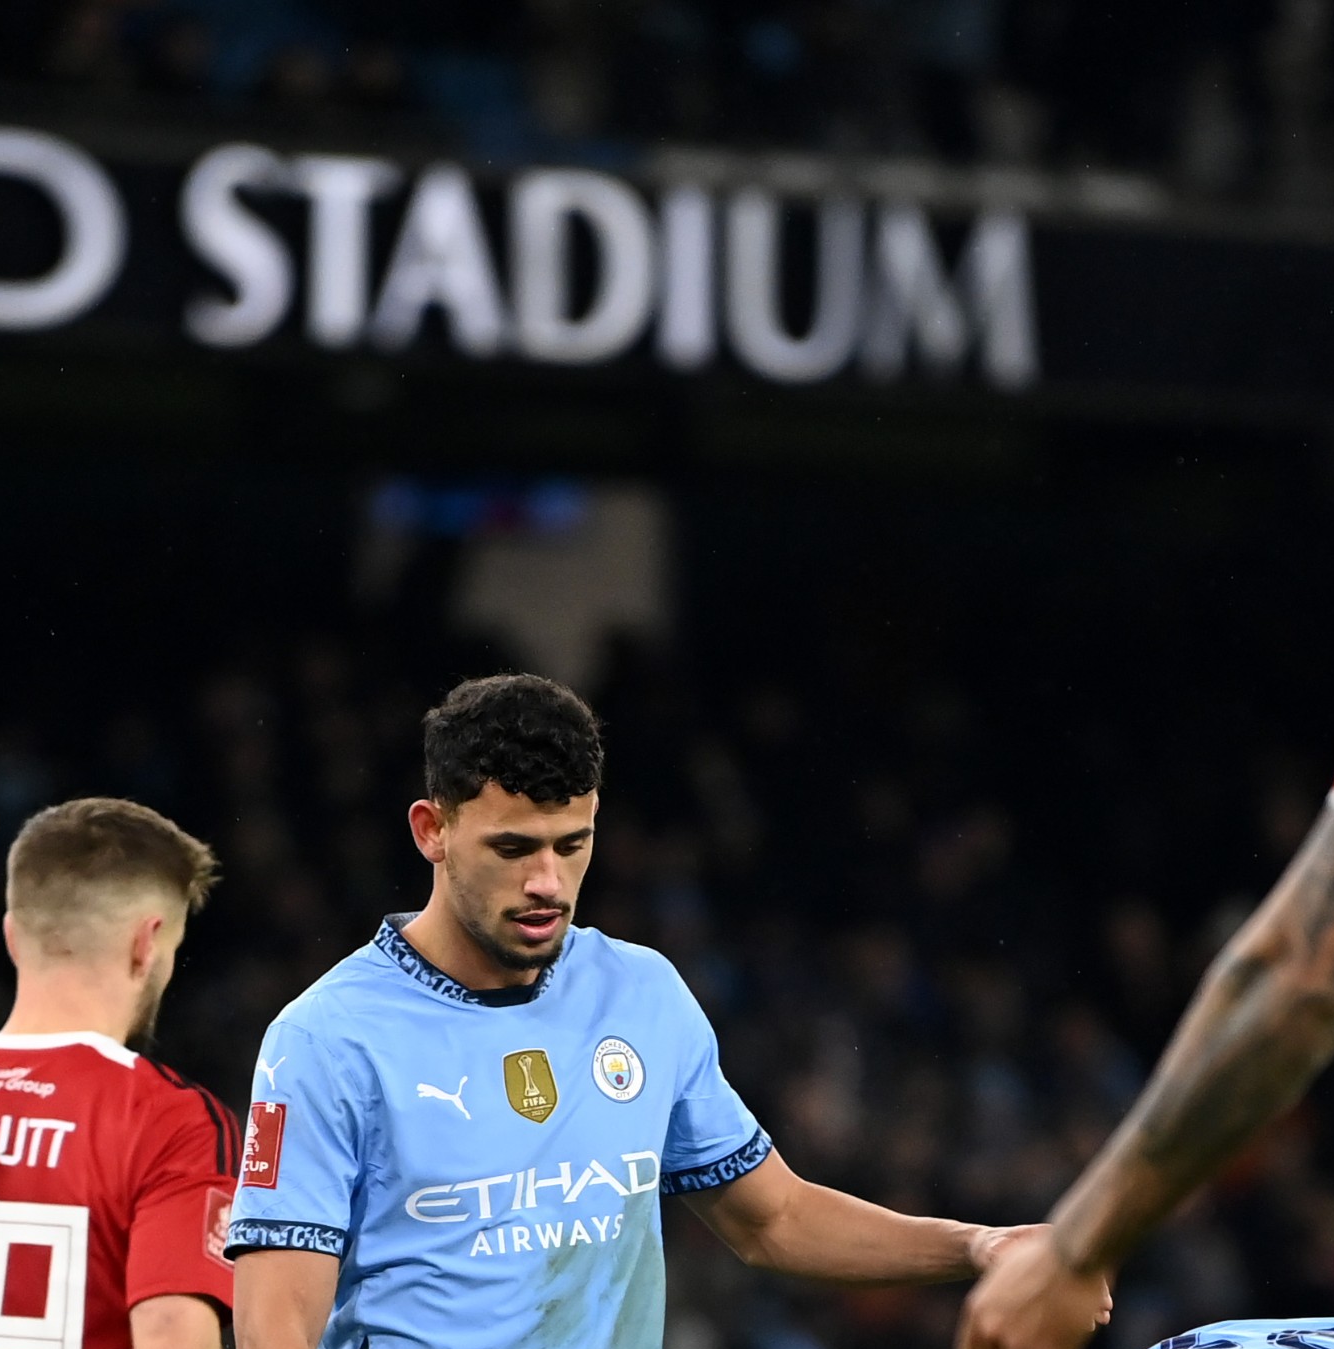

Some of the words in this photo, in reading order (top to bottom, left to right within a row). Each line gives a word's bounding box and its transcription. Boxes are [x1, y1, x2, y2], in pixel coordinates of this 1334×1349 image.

[180, 143, 1041, 390] STADIUM
[594, 1040, 635, 1063] MANCHESTER
[5, 1078, 56, 1099] Group
[615, 1091, 631, 1099] CITY
[522, 1096, 547, 1108] FIFA
[405, 1150, 660, 1223] ETIHAD
[470, 1213, 624, 1257] AIRWAYS
